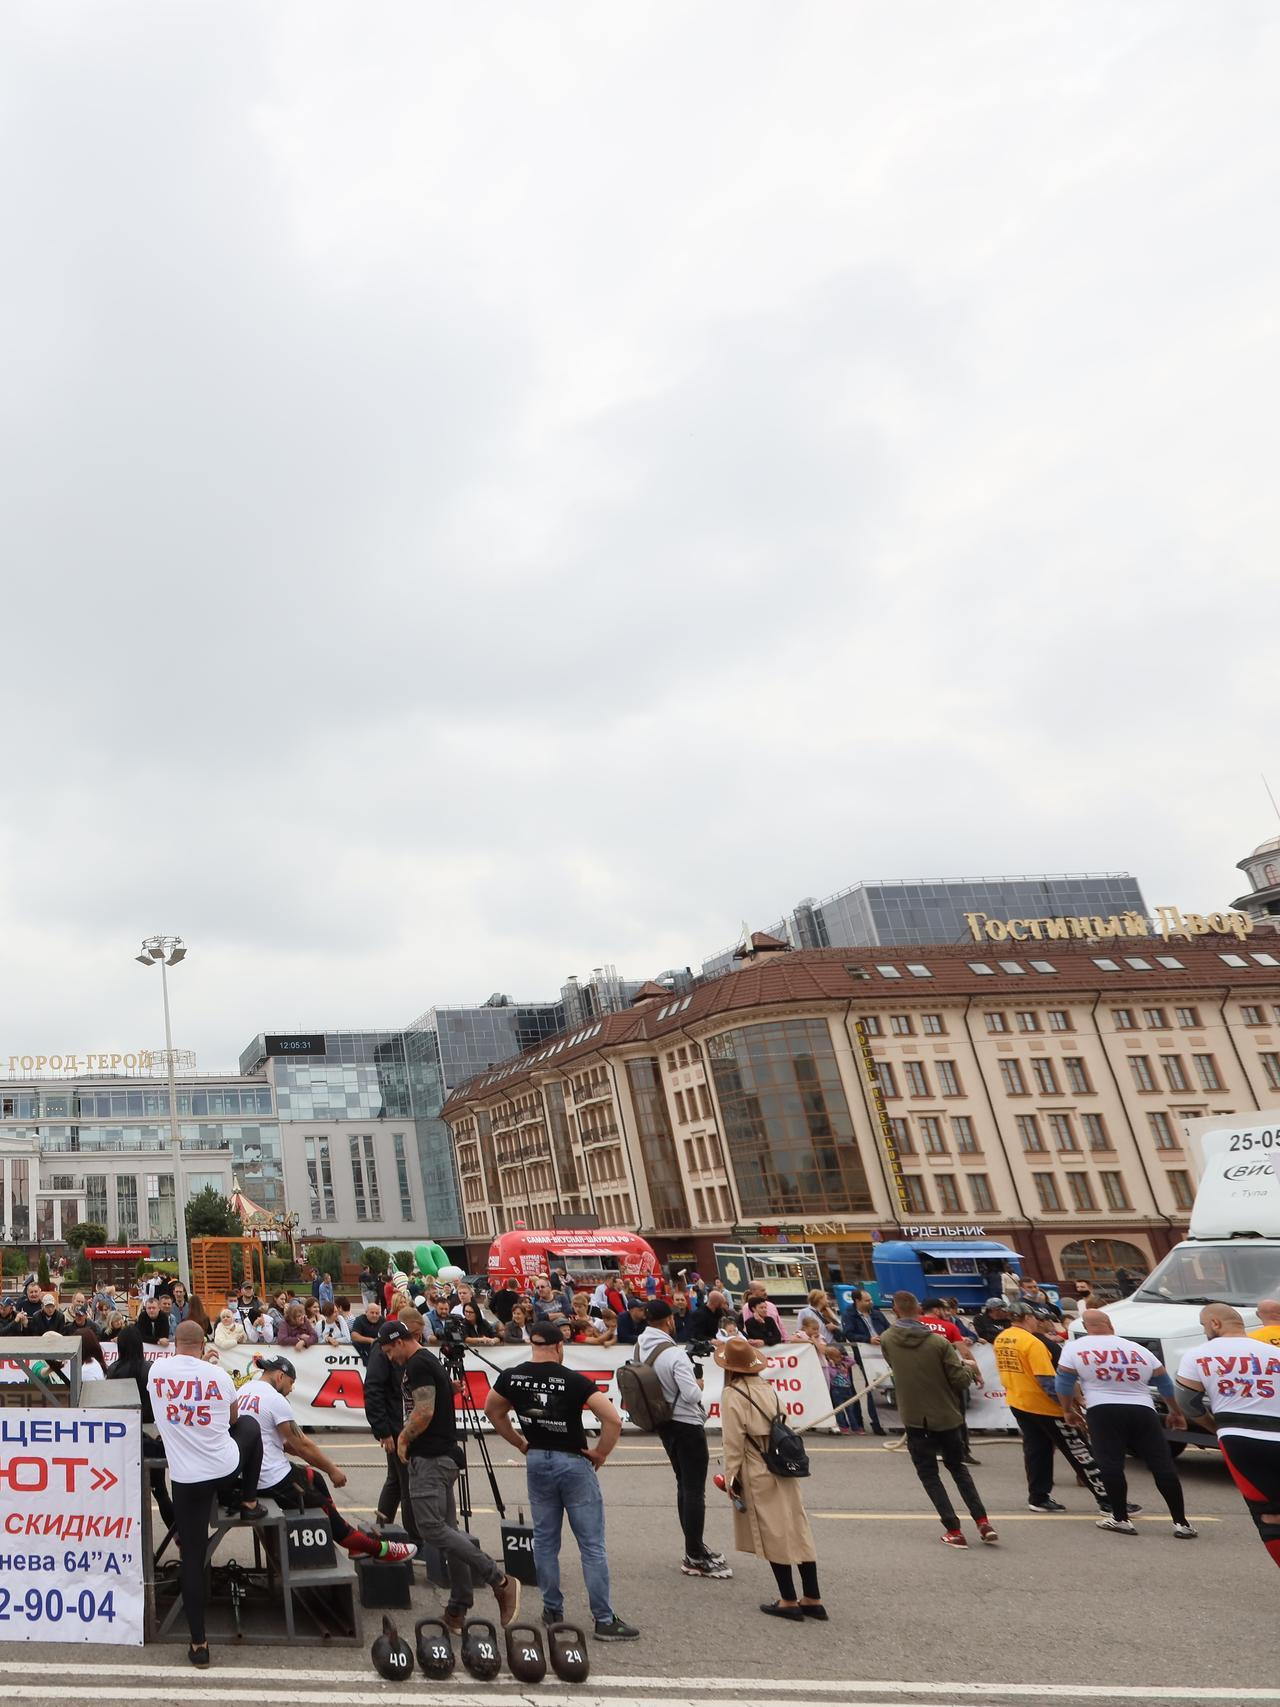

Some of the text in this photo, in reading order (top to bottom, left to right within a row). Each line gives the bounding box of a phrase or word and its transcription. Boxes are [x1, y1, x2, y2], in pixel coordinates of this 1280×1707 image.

[963, 905, 1255, 943] Гостиный Двор
[7, 1050, 154, 1074] ГОРОД-ГЕРОЙ
[855, 1022, 909, 1213] HOTEL RESTAURANT
[900, 1226, 986, 1238] ТРДЕЛЬНИК
[1077, 1349, 1148, 1366] ТУЛА
[1196, 1354, 1280, 1377] ТУЛА
[1095, 1367, 1141, 1382] 875
[153, 1377, 223, 1401] ТУЛА
[510, 1380, 565, 1391] FREEDOM
[1217, 1378, 1275, 1399] 875
[166, 1403, 211, 1426] 875
[5, 1513, 132, 1541] СКИДКИ!
[289, 1529, 328, 1547] 180
[432, 1646, 447, 1659] 32
[478, 1643, 494, 1659] 32
[522, 1649, 538, 1661] 24
[566, 1650, 582, 1663] 24
[390, 1653, 407, 1667] 40
